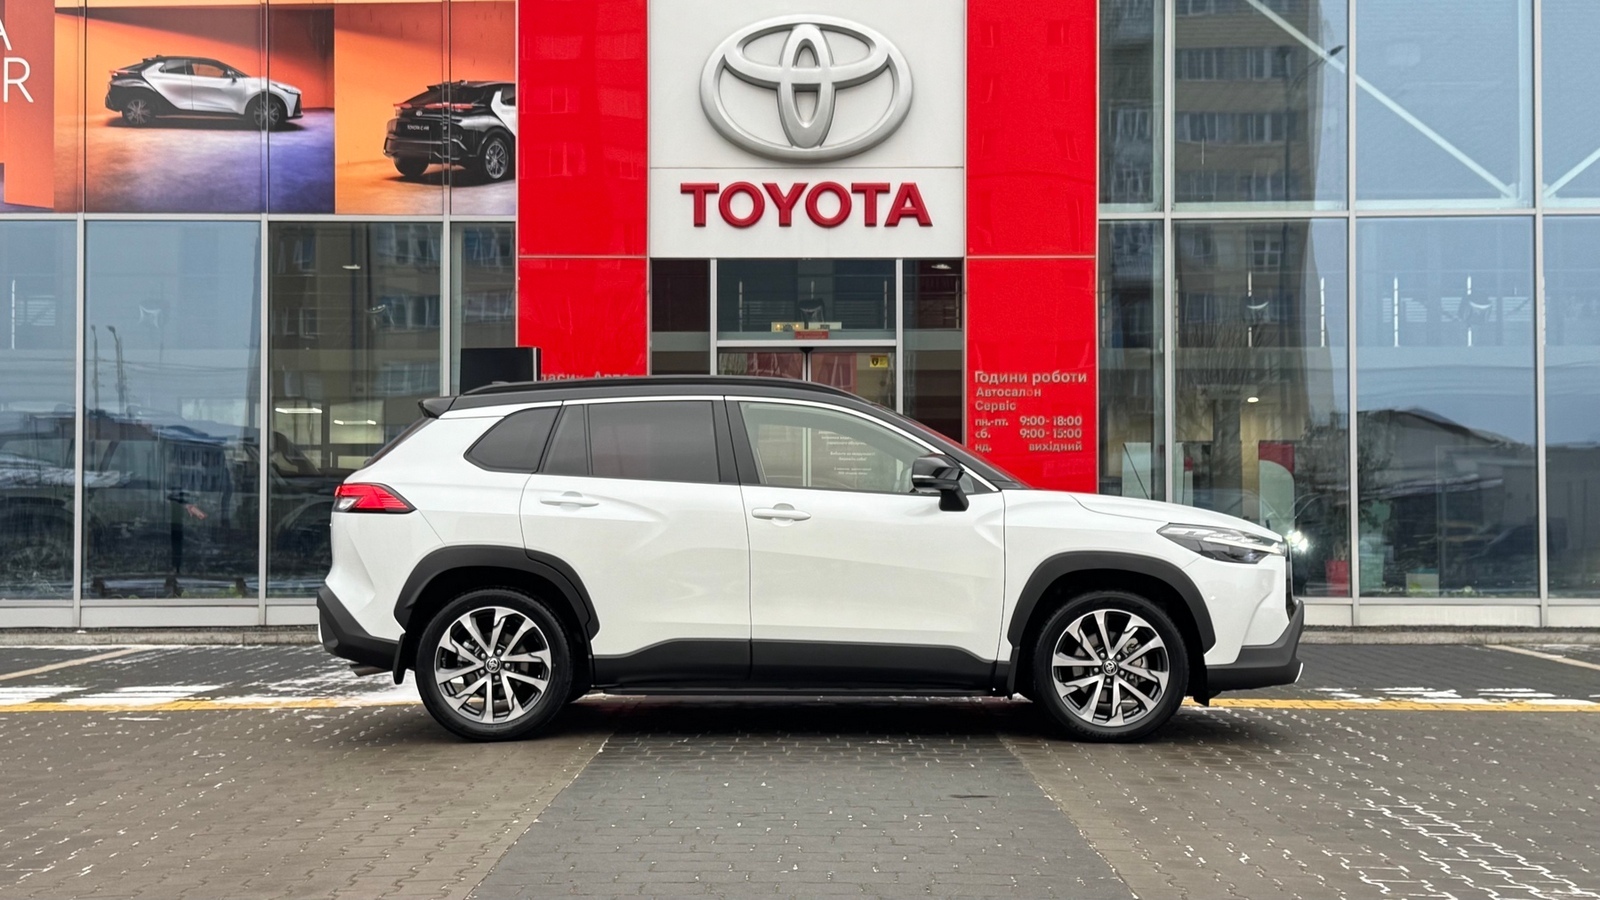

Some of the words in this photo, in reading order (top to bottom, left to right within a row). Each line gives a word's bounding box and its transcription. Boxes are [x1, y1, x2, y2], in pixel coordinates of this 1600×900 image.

[680, 181, 933, 229] TOYOTA
[975, 371, 1027, 385] Години
[1032, 370, 1087, 386] роботи
[976, 386, 1041, 397] Автосалон
[975, 400, 1016, 413] Сервіс
[975, 428, 991, 438] сб.
[1029, 441, 1082, 452] вихідний
